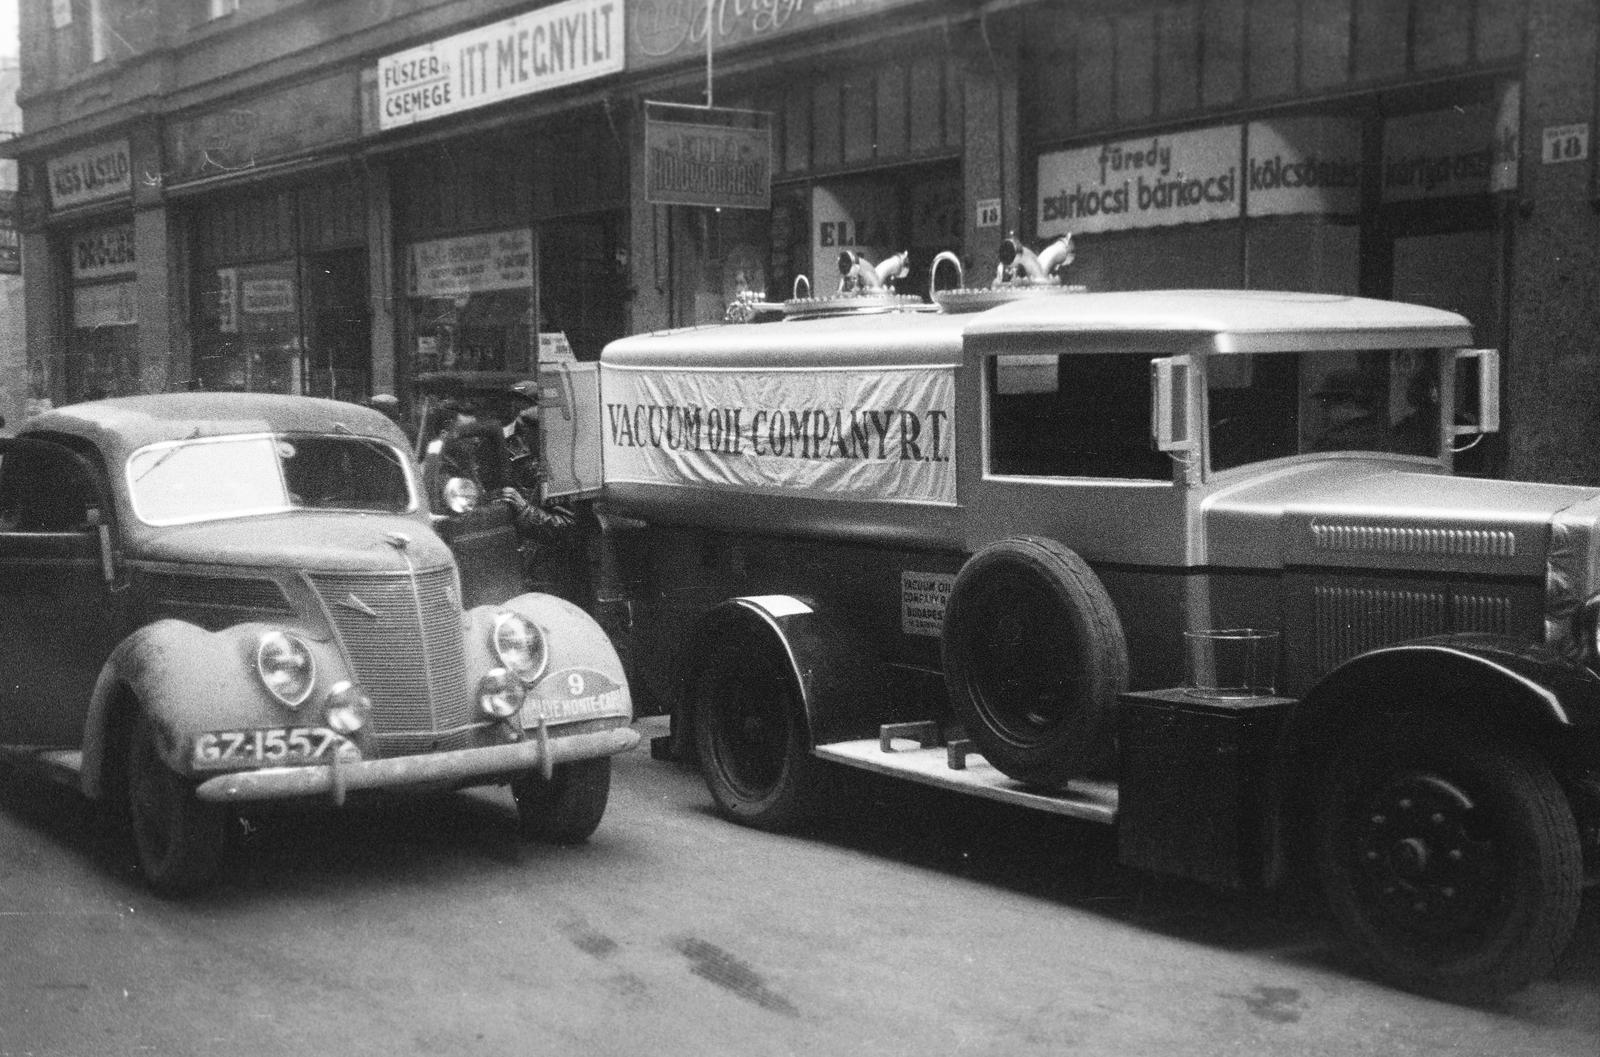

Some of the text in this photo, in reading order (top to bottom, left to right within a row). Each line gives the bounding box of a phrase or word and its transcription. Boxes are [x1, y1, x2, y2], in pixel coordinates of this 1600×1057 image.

[458, 41, 489, 98] ITT
[496, 4, 614, 89] MEGNYILT
[386, 82, 452, 117] CSEMEGE
[1552, 135, 1582, 160] 18
[606, 402, 950, 463] VACUUM OIL COMPANY R.T.
[567, 673, 584, 695] 9
